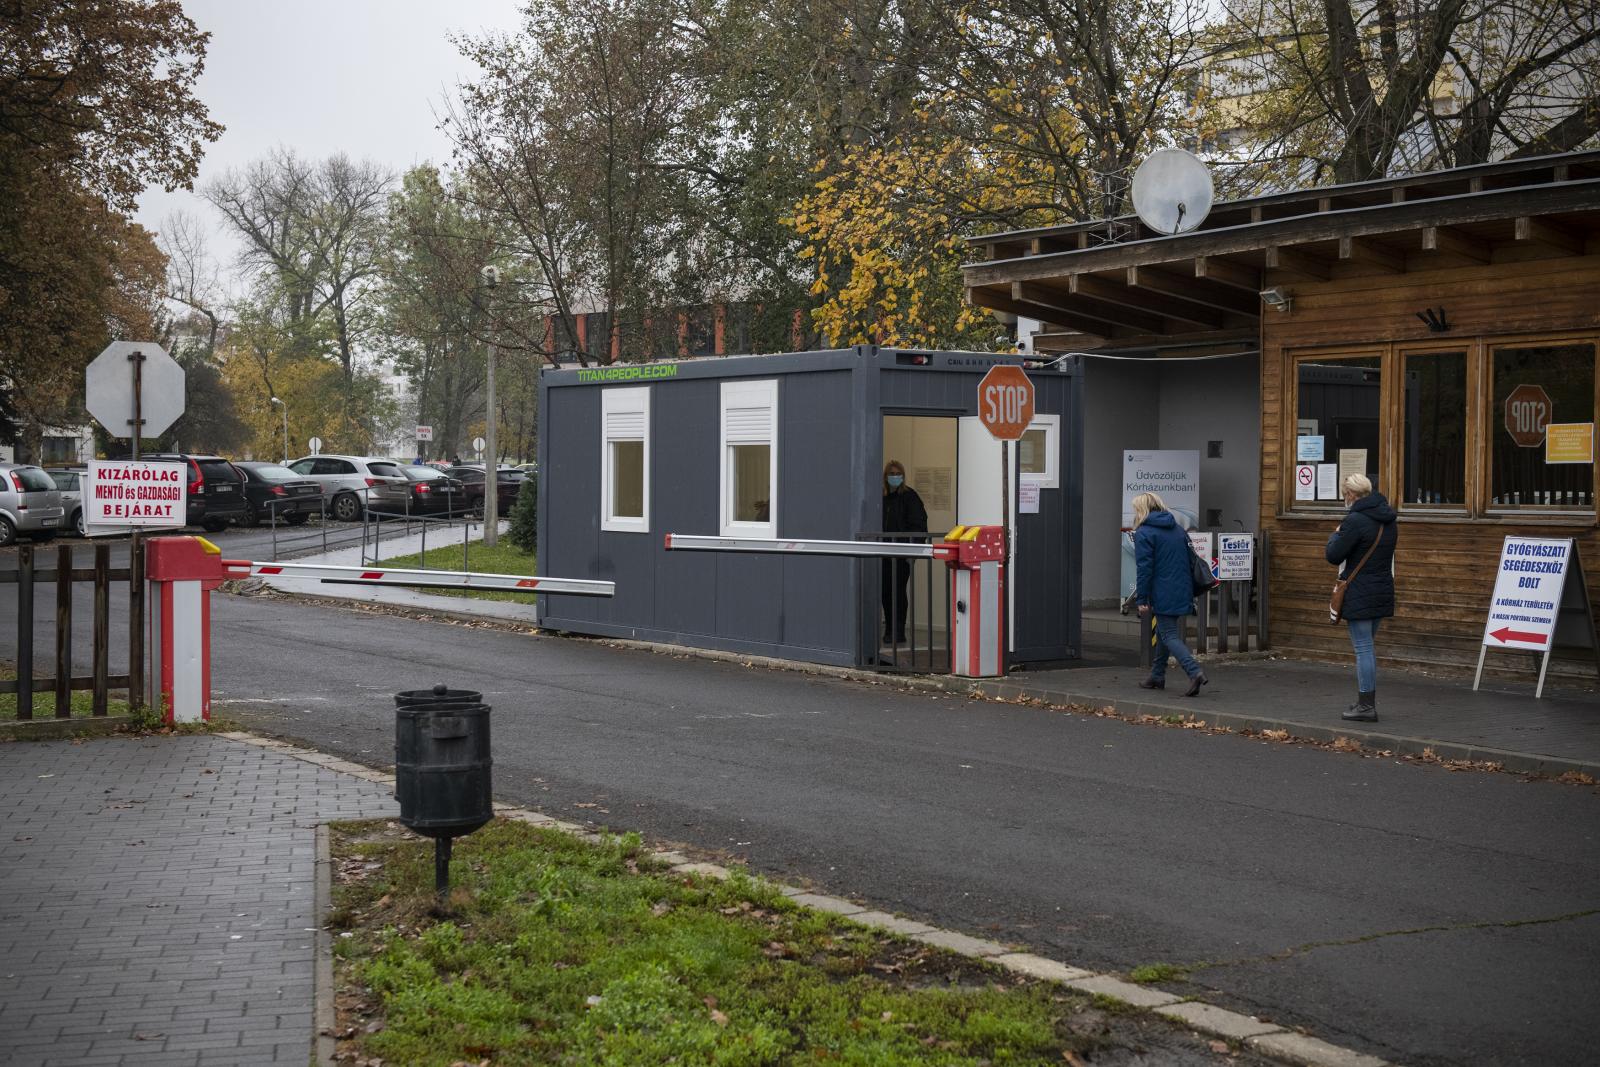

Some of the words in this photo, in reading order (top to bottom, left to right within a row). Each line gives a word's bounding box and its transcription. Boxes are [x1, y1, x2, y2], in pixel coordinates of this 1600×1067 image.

[577, 364, 677, 381] TITAN4PEOPLE.COM
[985, 385, 1028, 424] STOP
[97, 466, 178, 482] KIZÁRÓLAG
[1136, 469, 1187, 481] Üdvözöljük
[95, 483, 123, 500] MENTŐ
[125, 484, 135, 500] és
[137, 484, 181, 501] GAZDASÁGI
[1126, 482, 1196, 492] Kórházunkban!
[103, 501, 172, 518] BEJÁRAT
[1506, 543, 1566, 558] GYÓGYÁSZATI
[1503, 559, 1564, 574] SEGÉDESZKÖZ
[1518, 576, 1541, 589] BOLT
[1496, 598, 1500, 606] A
[1500, 598, 1524, 607] KÓRHÁZ
[1524, 600, 1554, 610] TERÜLETÉN
